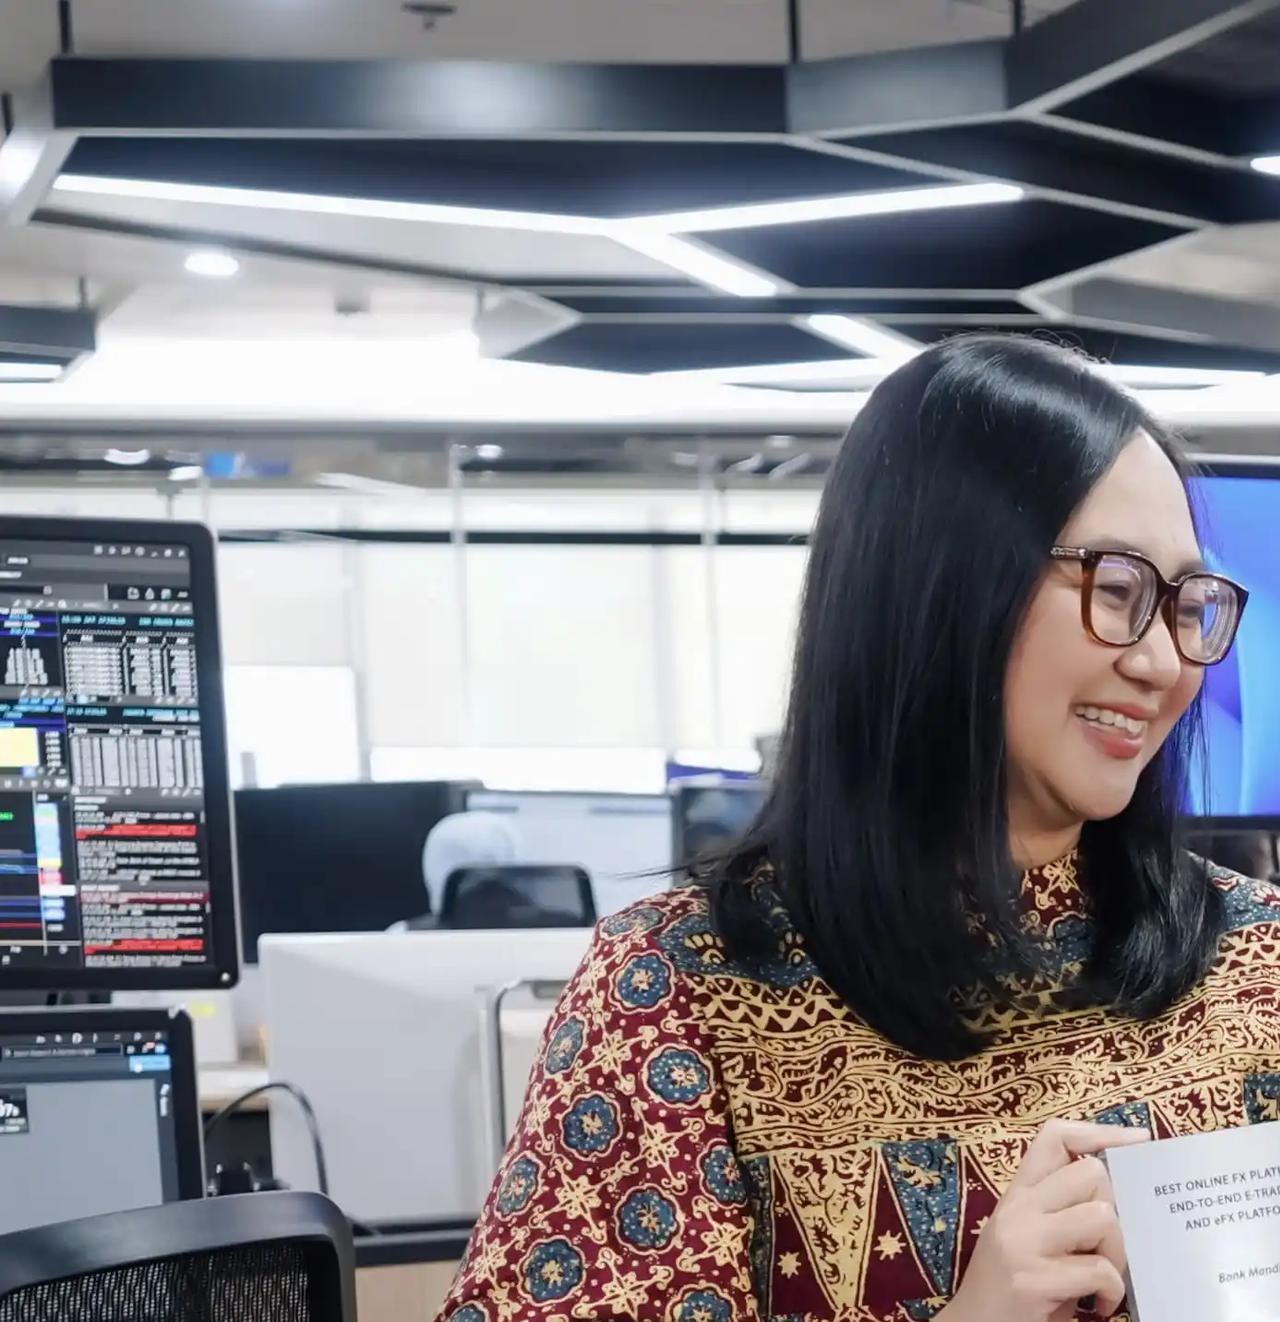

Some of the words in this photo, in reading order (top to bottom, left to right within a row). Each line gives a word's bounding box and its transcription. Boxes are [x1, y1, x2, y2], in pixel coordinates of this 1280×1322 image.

[1154, 1183, 1182, 1197] BEST
[1186, 1174, 1229, 1192] ONLINE
[1232, 1171, 1247, 1183] FX
[1169, 1191, 1242, 1214] END-TO-END
[1185, 1214, 1211, 1232] AND
[1215, 1213, 1236, 1226] eFX
[1218, 1269, 1246, 1284] Bank
